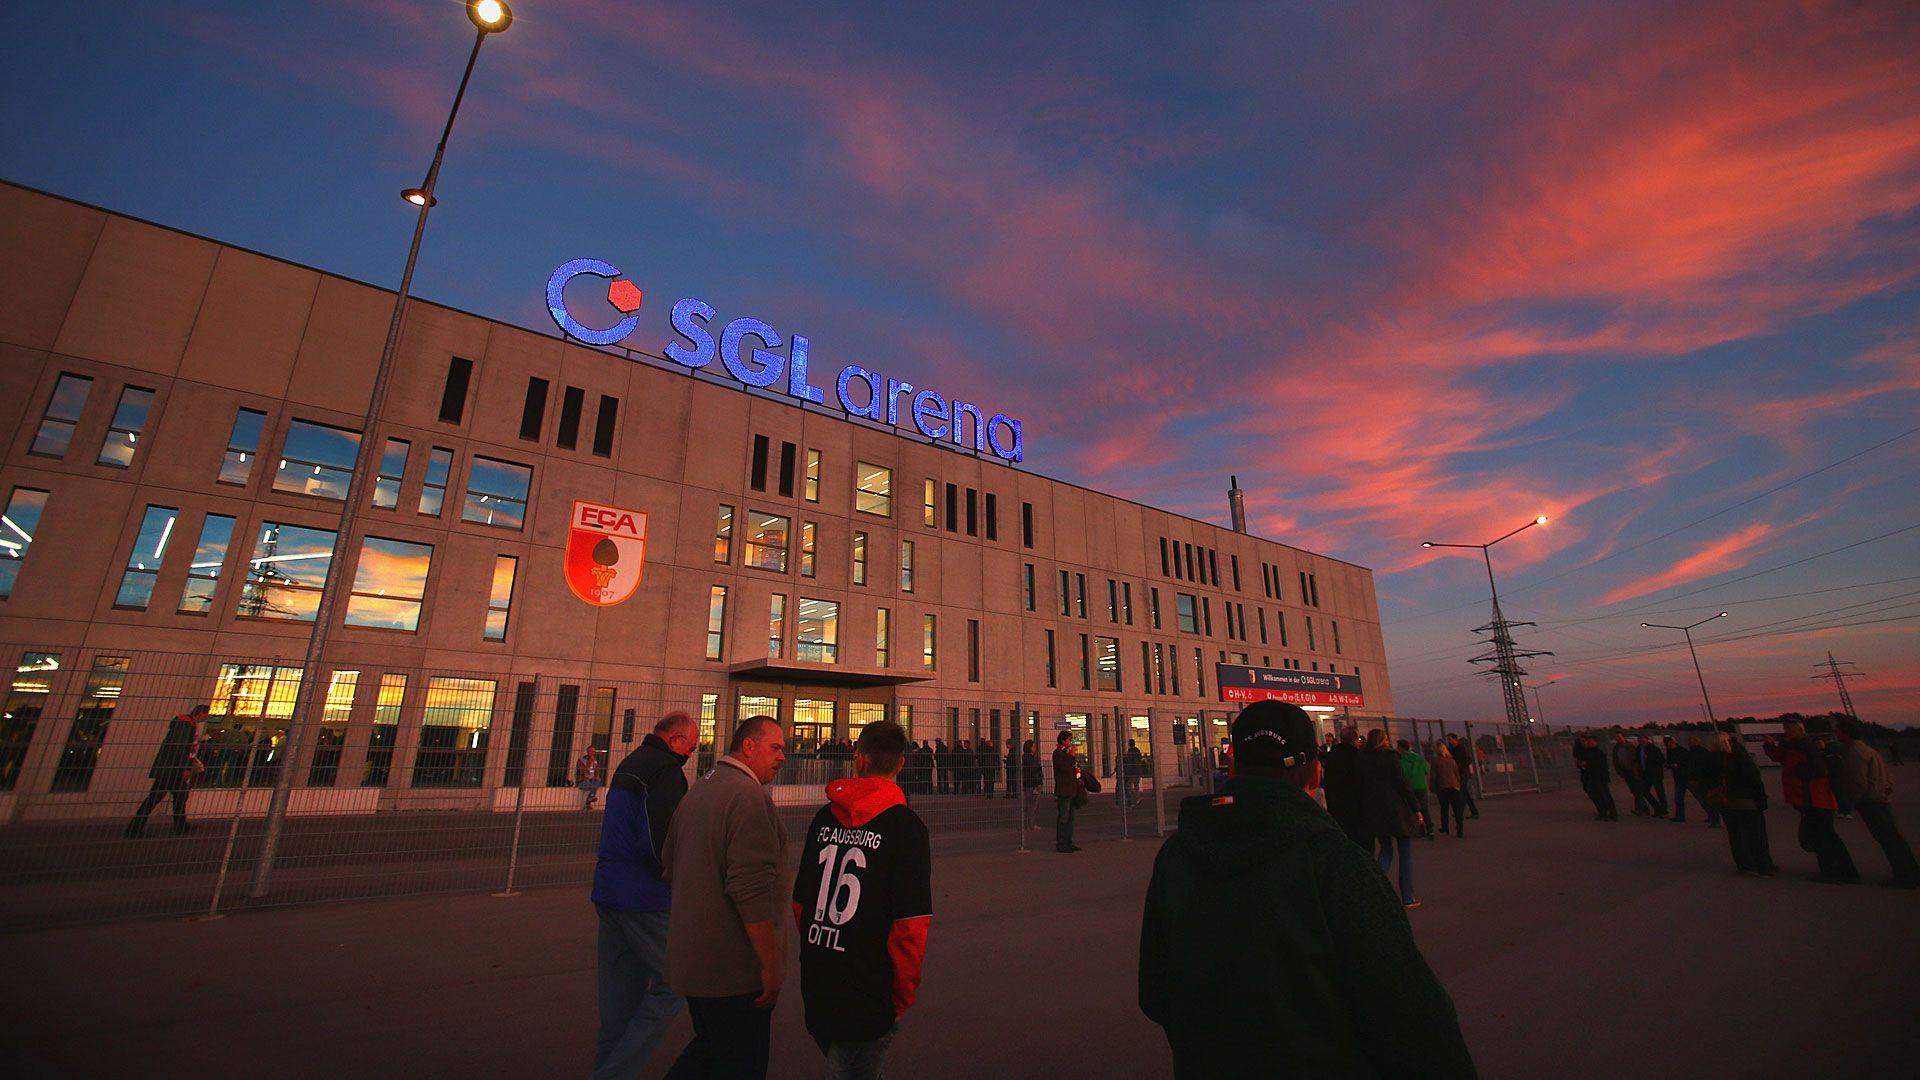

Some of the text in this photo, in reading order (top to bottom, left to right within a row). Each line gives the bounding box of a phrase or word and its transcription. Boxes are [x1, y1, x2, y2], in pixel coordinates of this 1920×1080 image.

[663, 297, 1023, 462] SGL arena
[581, 507, 637, 534] FCA
[590, 588, 615, 599] 1907
[1306, 676, 1316, 685] SGL
[1316, 677, 1330, 686] arena
[817, 826, 882, 849] FC AUGSBURG
[814, 844, 866, 925] 16
[808, 924, 845, 952] OTTL
